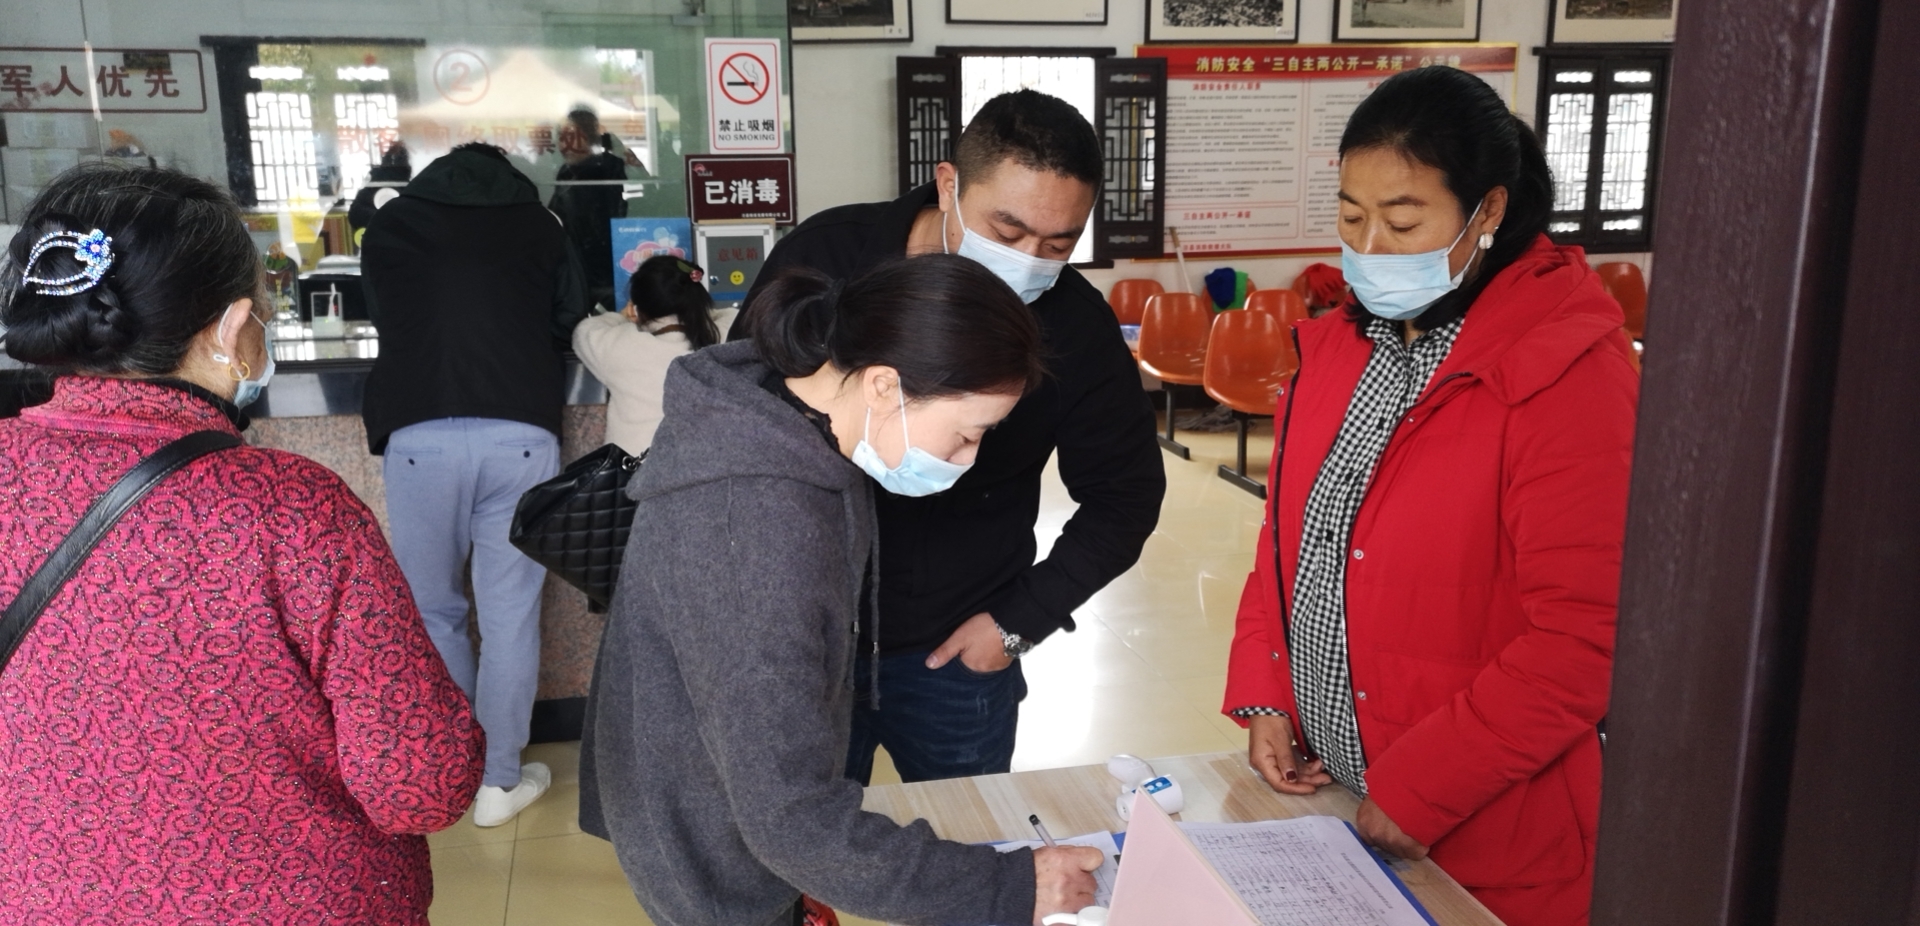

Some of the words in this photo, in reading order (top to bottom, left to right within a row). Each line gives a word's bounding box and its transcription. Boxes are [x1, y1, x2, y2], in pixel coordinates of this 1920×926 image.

[0, 64, 180, 99] 军人优先
[718, 119, 775, 132] 禁止吸烟
[733, 133, 775, 141] SMOKING
[704, 177, 780, 205] 已消毒
